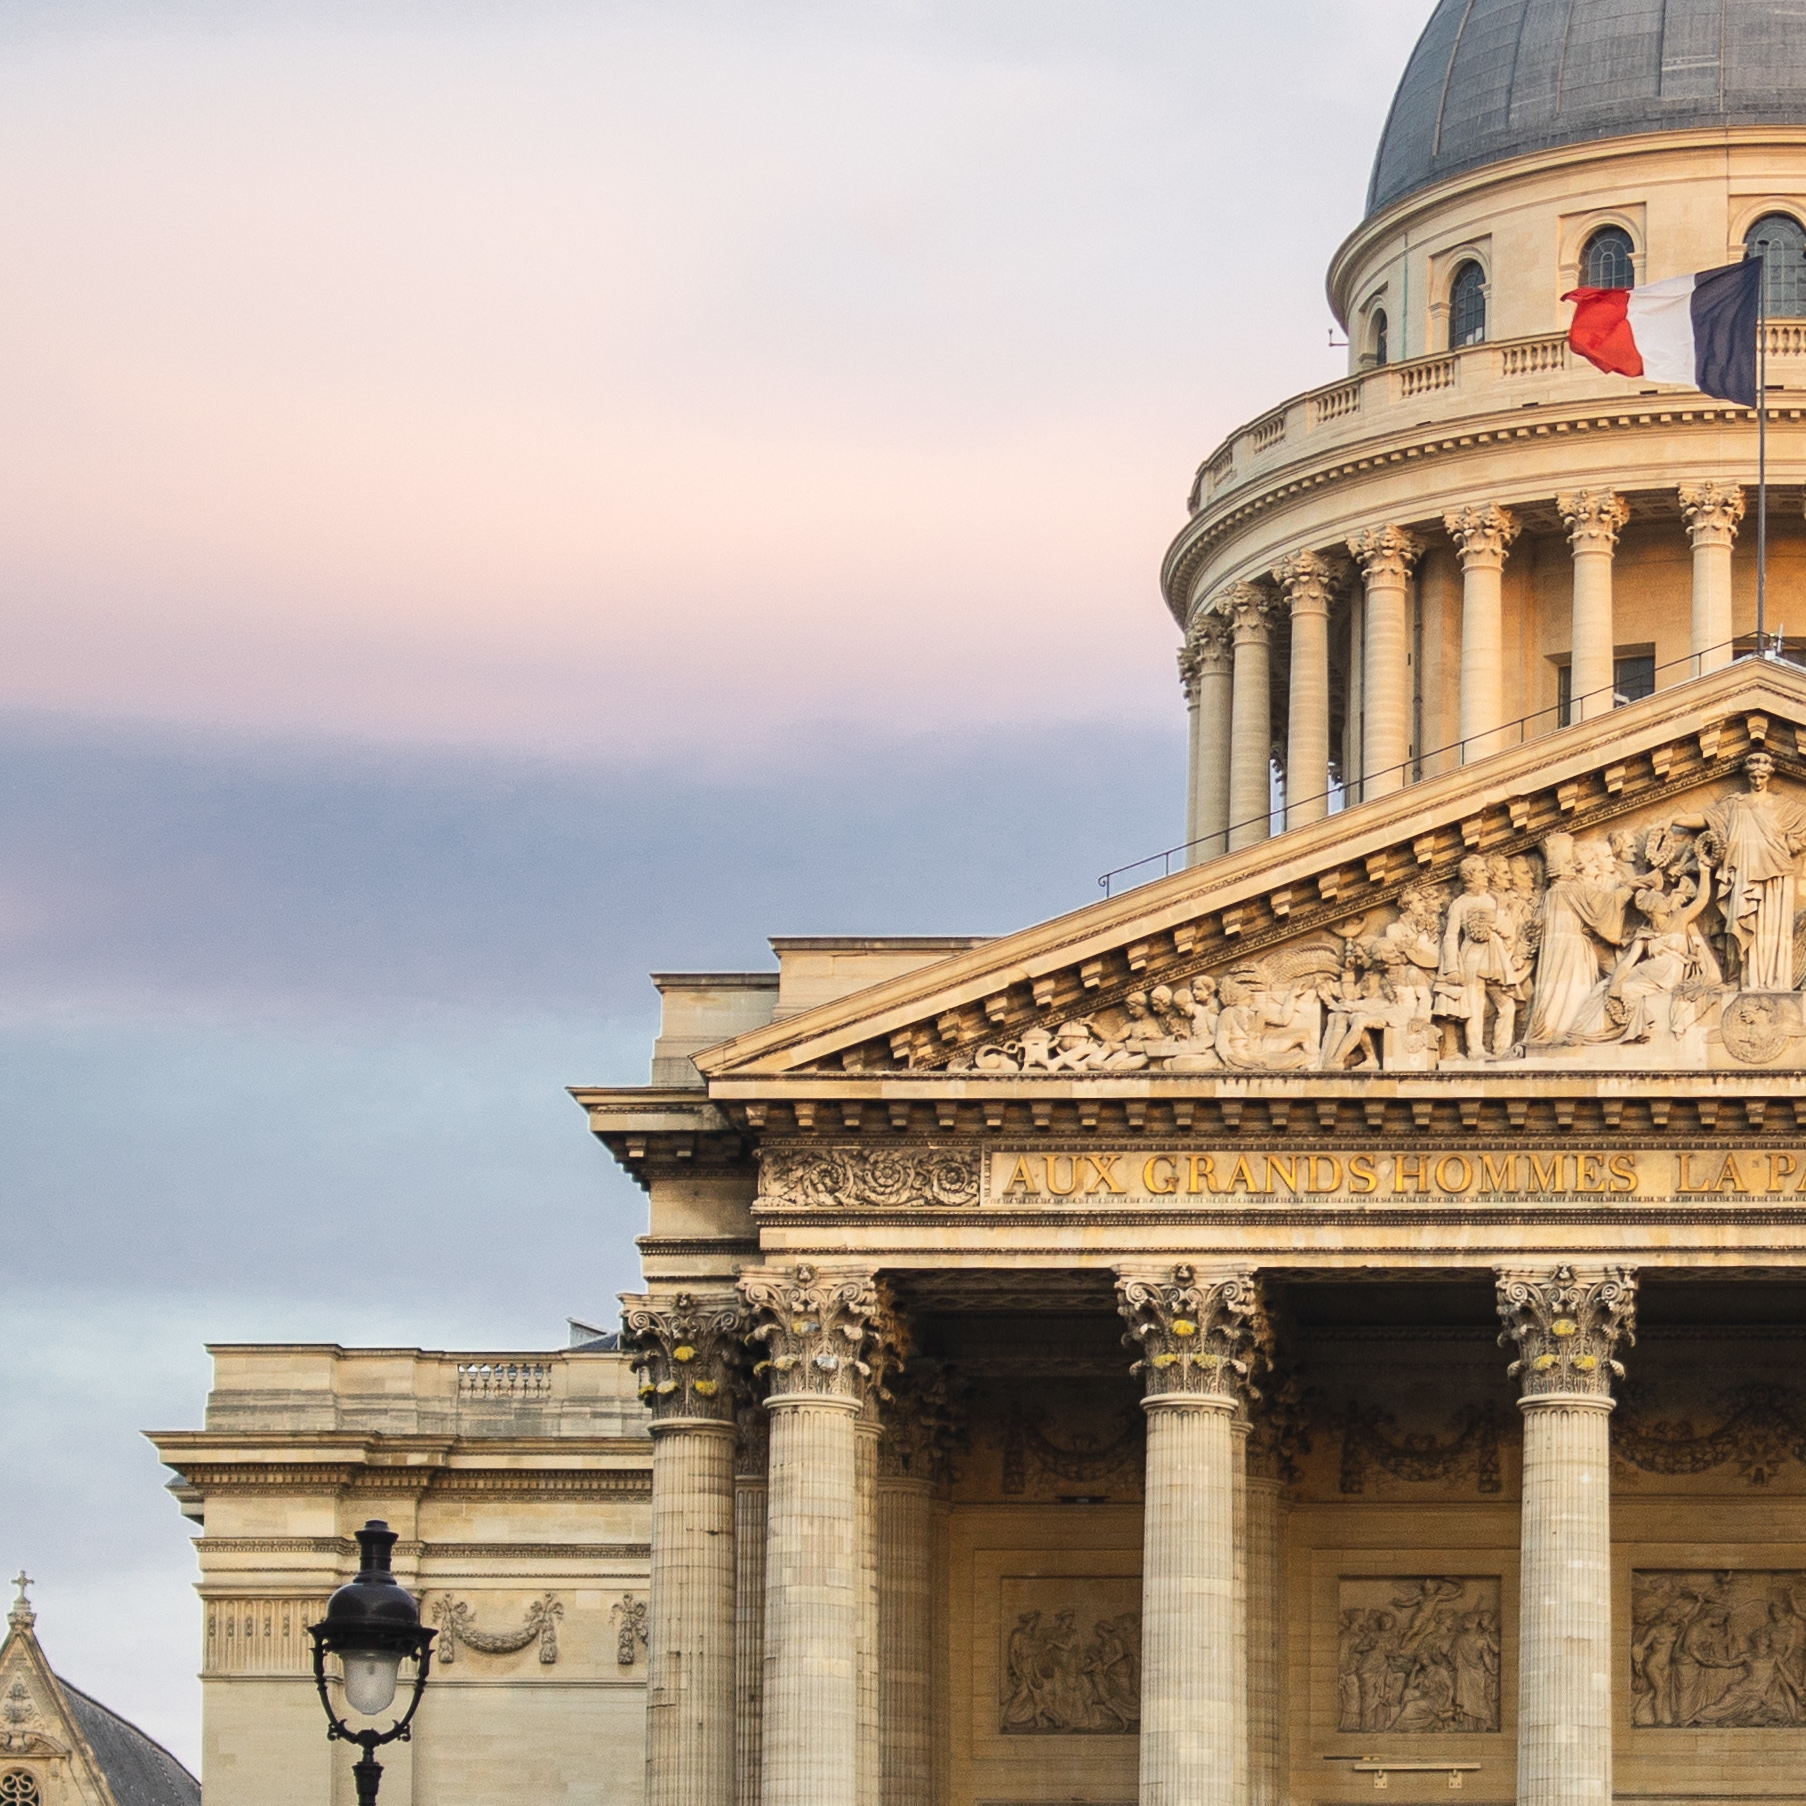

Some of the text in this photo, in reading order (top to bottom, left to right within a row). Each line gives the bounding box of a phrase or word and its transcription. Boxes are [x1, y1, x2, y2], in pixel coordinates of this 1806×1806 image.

[1002, 1152, 1128, 1196] AUX
[1142, 1151, 1379, 1196] GRANDS
[1393, 1150, 1639, 1194] HOMMES
[1674, 1152, 1748, 1194] LA
